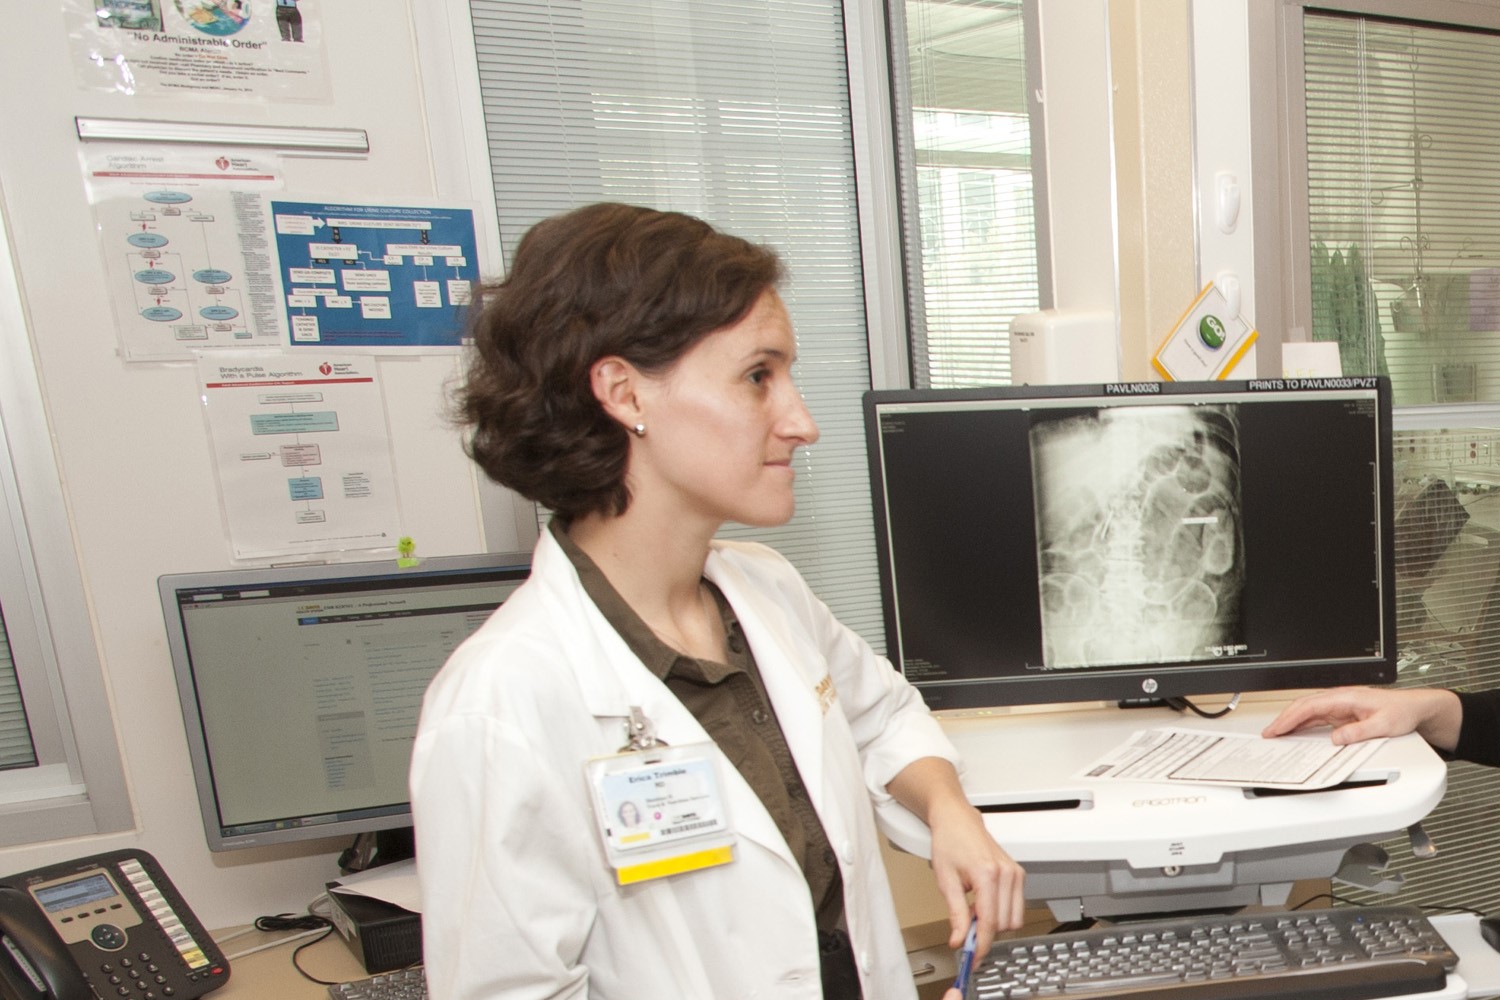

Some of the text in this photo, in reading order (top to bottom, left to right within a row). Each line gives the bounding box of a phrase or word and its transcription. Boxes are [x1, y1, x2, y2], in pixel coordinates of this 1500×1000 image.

[153, 33, 229, 47] Administrable
[219, 366, 264, 374] Bradycardia
[269, 371, 303, 379] Algorithm
[1106, 383, 1160, 394] PAVLN0026
[1250, 378, 1378, 391] PRINTS TO PAVLN0033/PVZT
[628, 776, 652, 784] Erica
